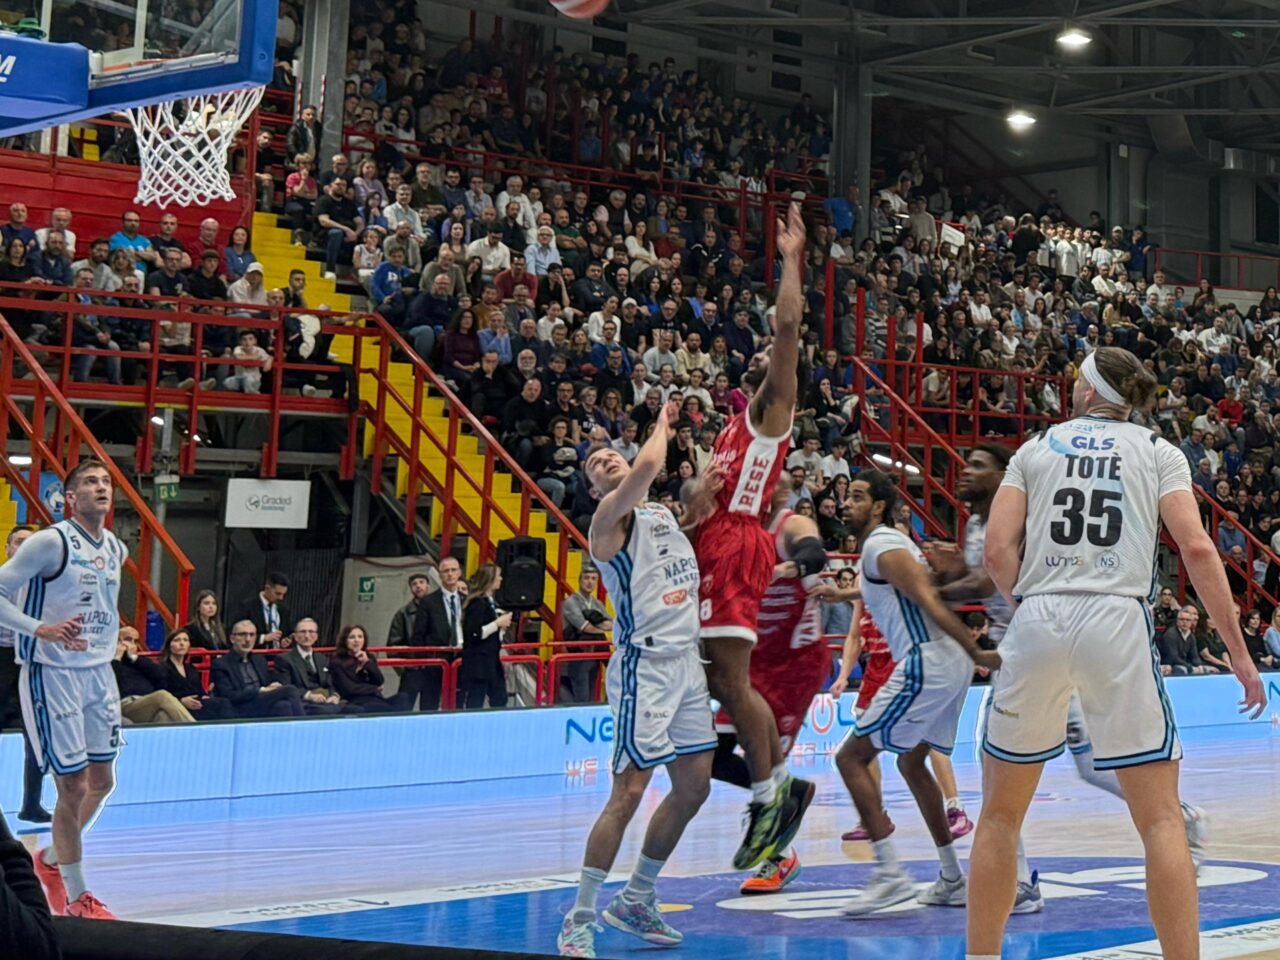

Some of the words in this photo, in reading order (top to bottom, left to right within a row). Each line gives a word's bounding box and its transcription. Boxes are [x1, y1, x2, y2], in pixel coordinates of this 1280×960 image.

[1065, 451, 1123, 481] TOTÈ
[261, 494, 292, 506] Graded
[1051, 487, 1123, 547] 35
[69, 535, 82, 550] 5
[109, 724, 120, 748] 5
